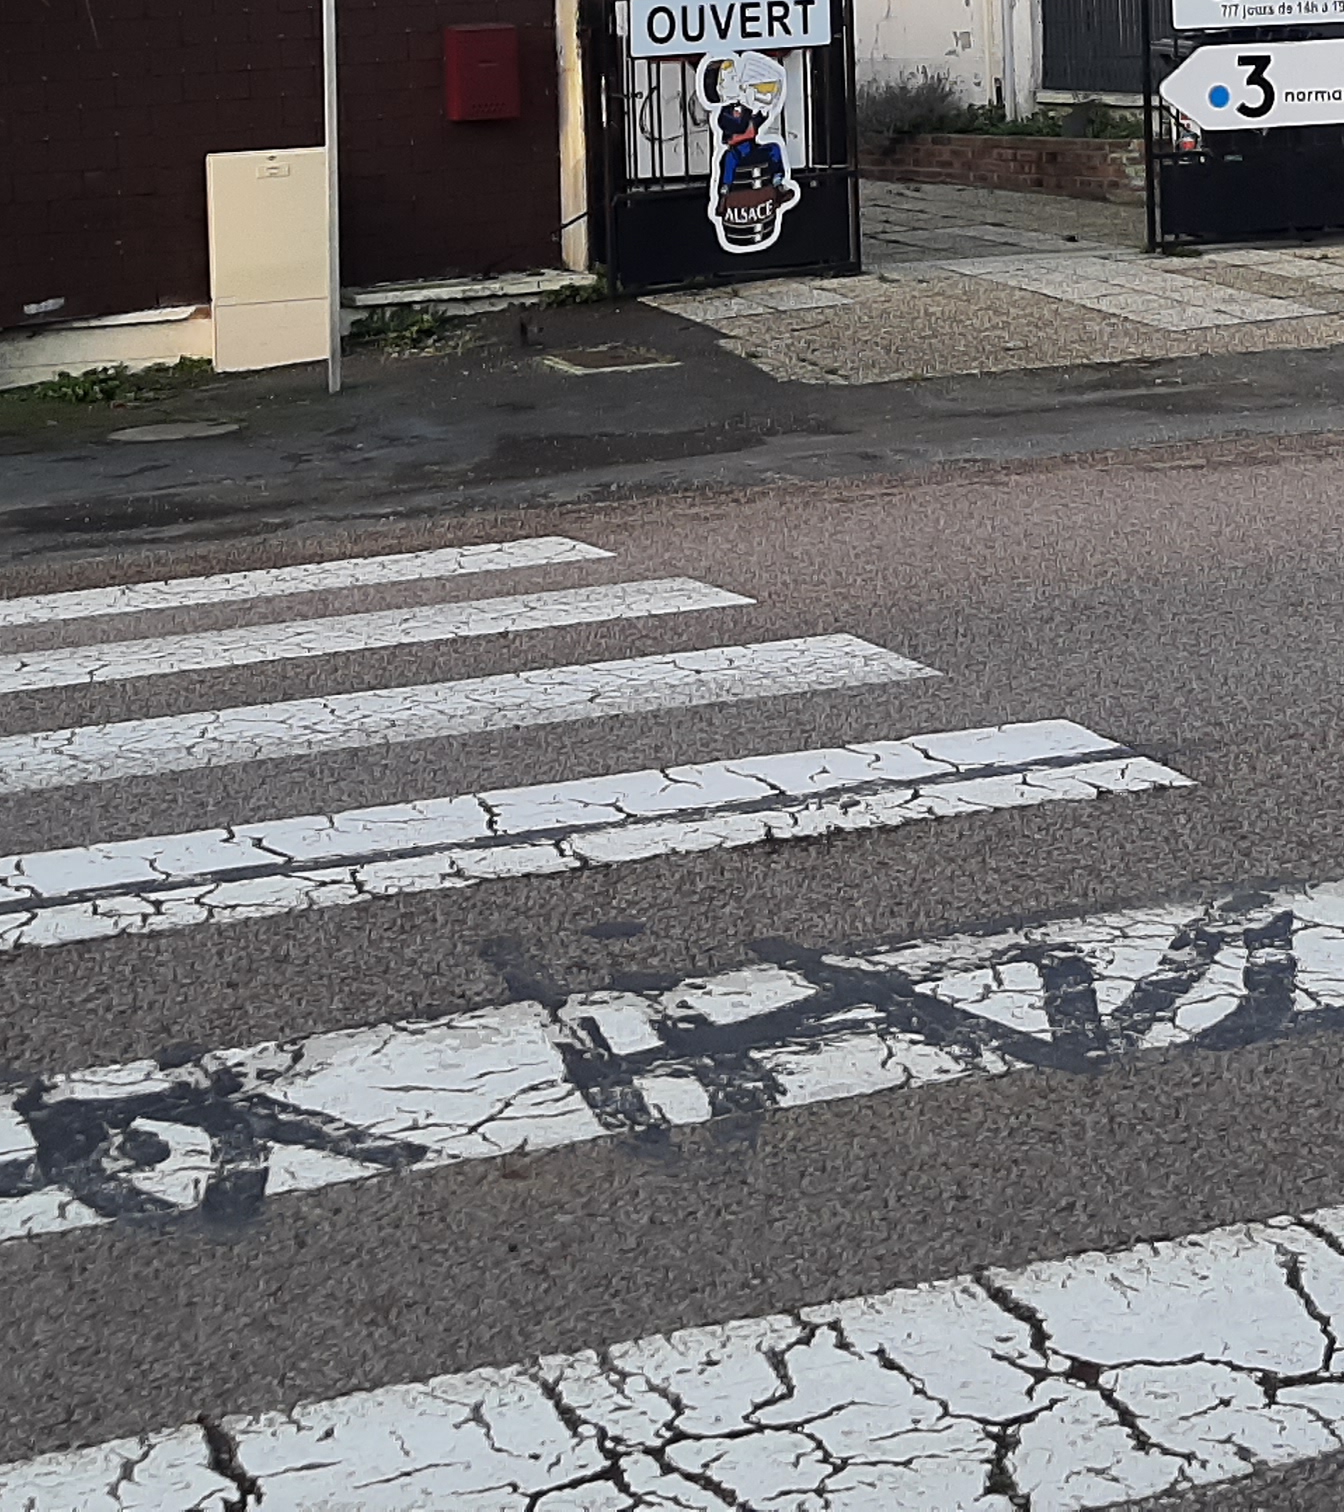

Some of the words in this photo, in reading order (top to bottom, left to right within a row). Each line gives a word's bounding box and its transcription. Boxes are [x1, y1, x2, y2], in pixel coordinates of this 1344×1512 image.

[1242, 4, 1275, 18] jours
[1278, 2, 1293, 14] de
[1236, 55, 1275, 119] 3
[724, 199, 774, 223] ALSACE
